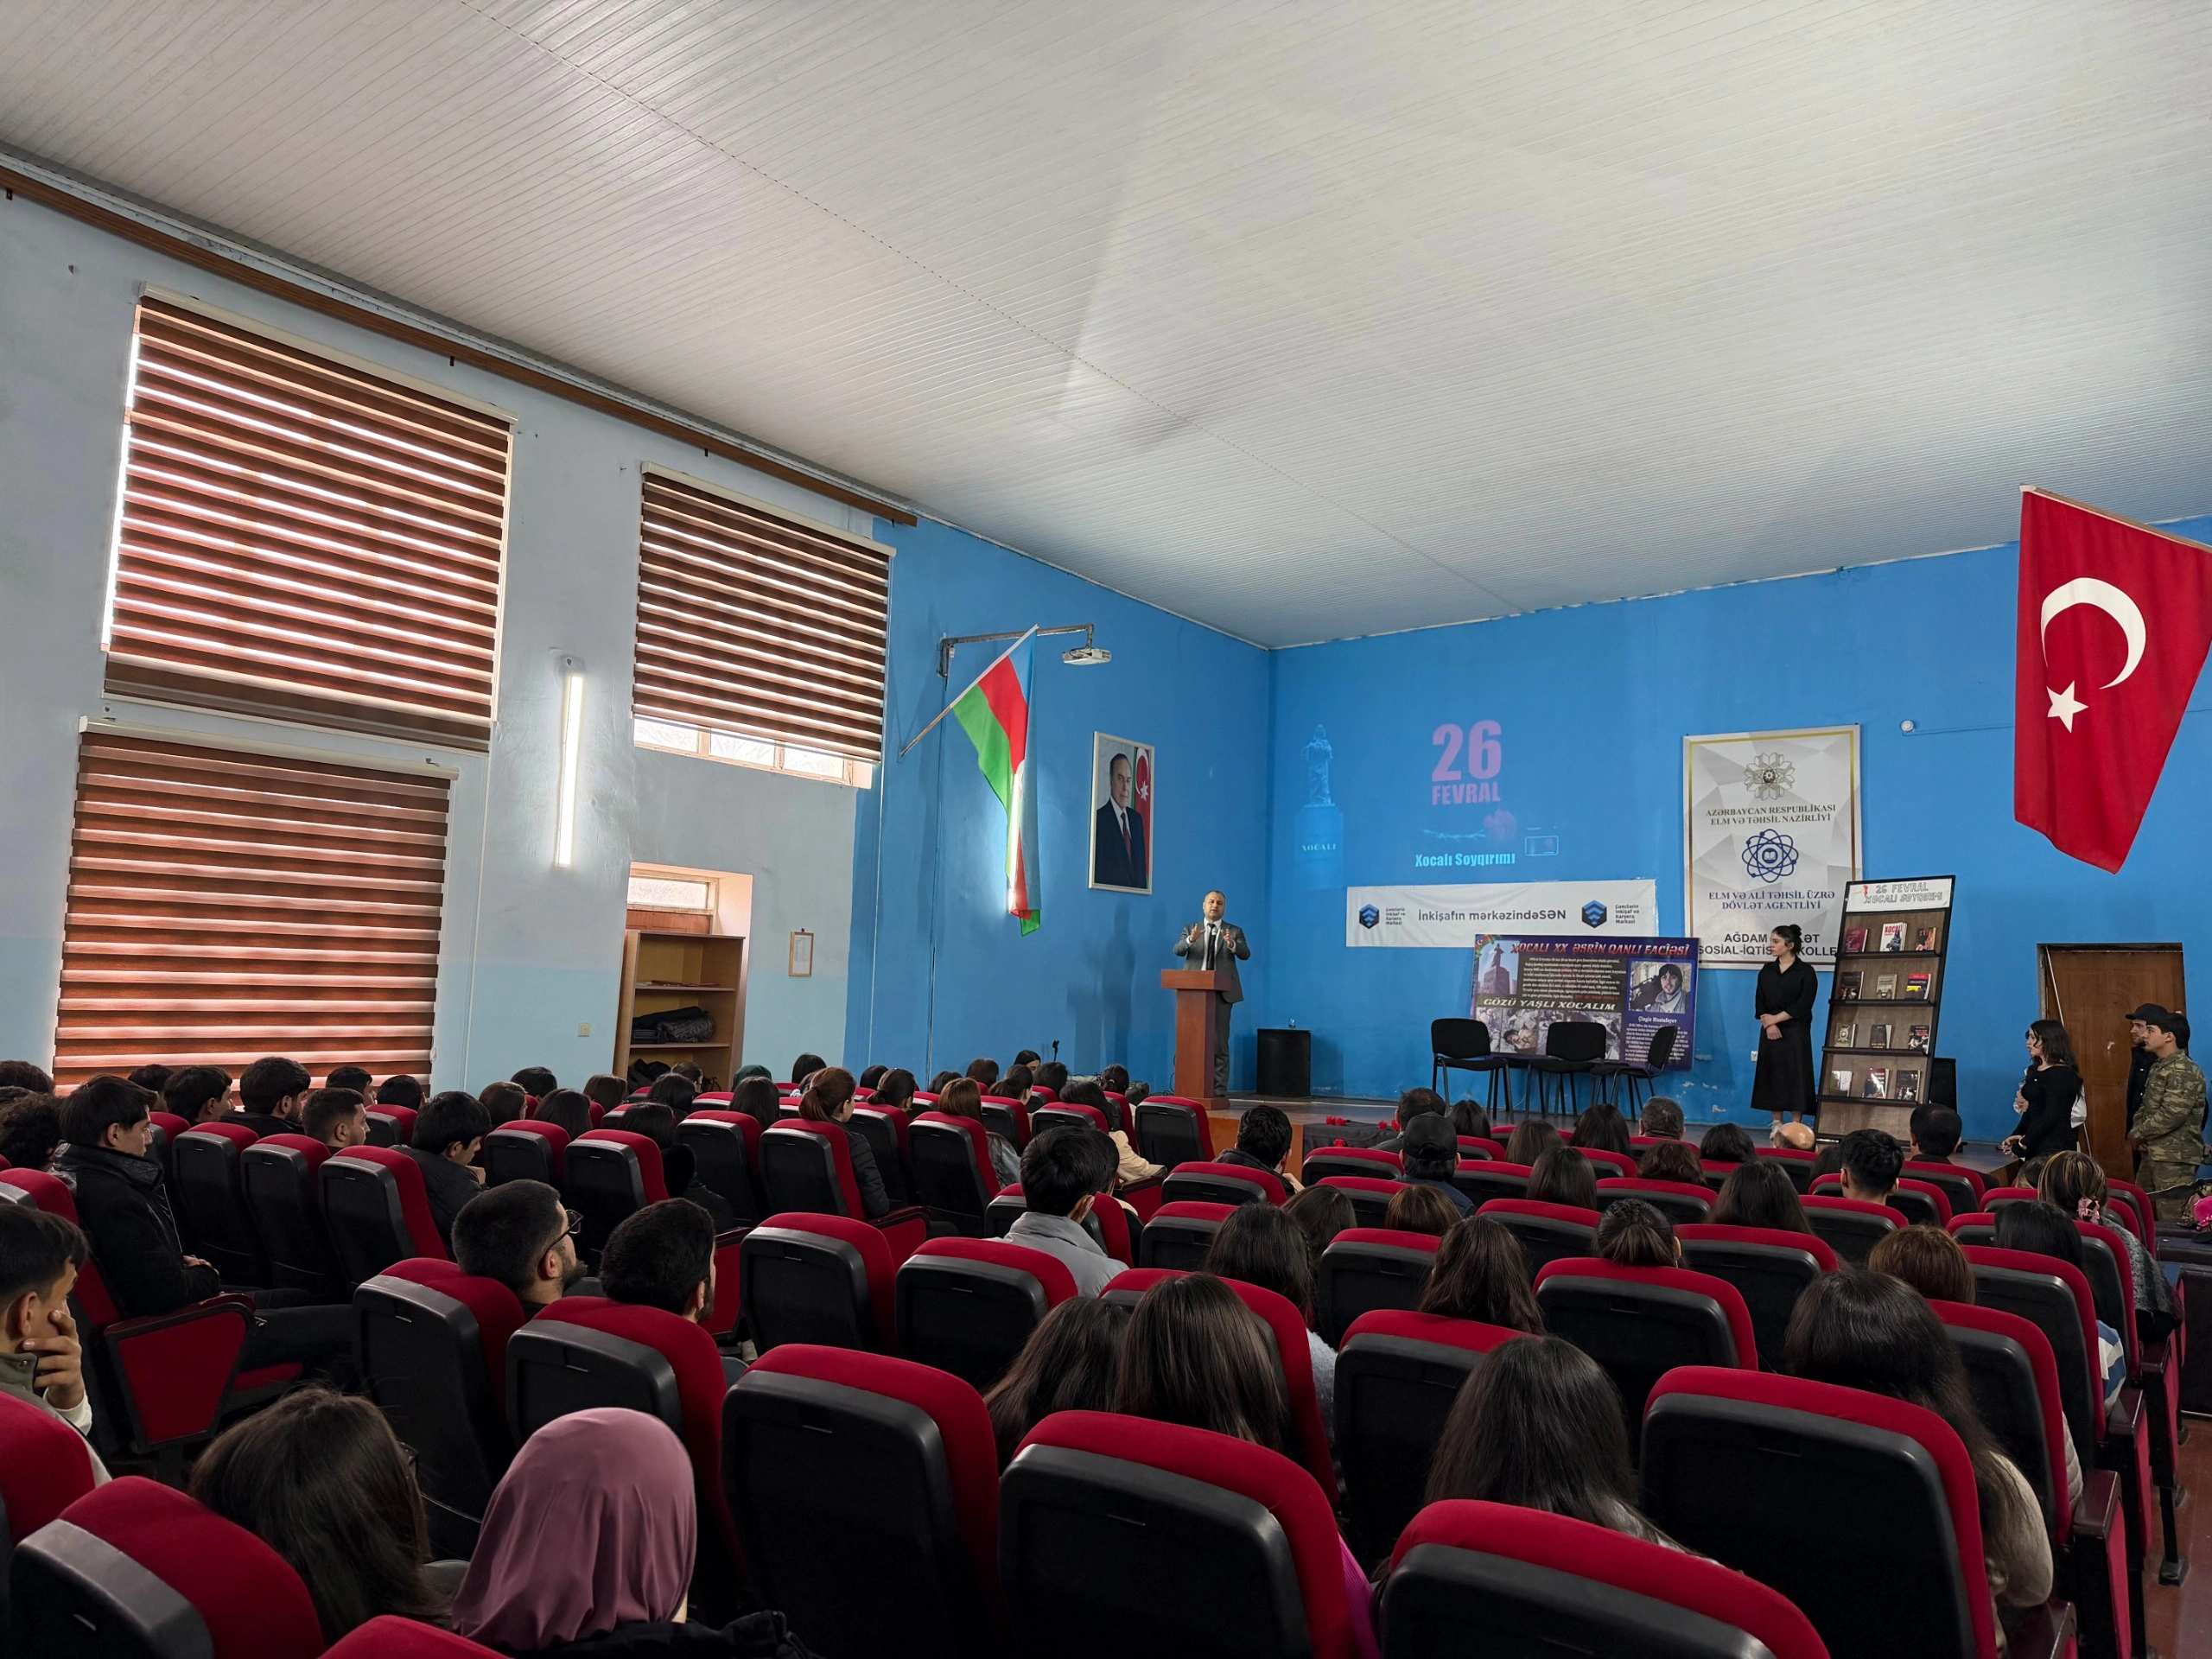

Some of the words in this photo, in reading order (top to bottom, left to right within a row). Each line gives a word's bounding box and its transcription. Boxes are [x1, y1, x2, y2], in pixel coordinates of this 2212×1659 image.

[1432, 720, 1502, 782] 26
[1432, 781, 1501, 805] FEVRAL
[1706, 807, 1767, 817] AZƏRBAYCAN
[1769, 804, 1836, 814] RESPUBLİKASI
[1711, 817, 1731, 825] ELM
[1748, 815, 1780, 824] TƏHSİL
[1782, 812, 1831, 823] NAZİRLİYİ
[1415, 854, 1452, 868] Xocalı
[1455, 853, 1516, 868] Soyqırımı
[1748, 891, 1764, 899] ALİ
[1767, 890, 1804, 899] TƏHSİL
[1807, 889, 1835, 899] ÜZRƏ
[1876, 885, 1888, 893] 26
[1892, 882, 1929, 893] FEVRAL
[1722, 900, 1763, 910] DÖVLƏT
[1764, 899, 1821, 910] AGENTLİYİ
[1864, 893, 1897, 904] XOCALI
[1418, 908, 1465, 922] İnkişafın
[1469, 909, 1567, 921] mərkəzindəSƏN
[1724, 931, 1767, 943] AĞDAM
[1511, 943, 1549, 954] XOCALI
[1554, 943, 1568, 952] XX
[1573, 942, 1606, 953] ƏSRİN
[1608, 944, 1643, 955] QANLI
[1644, 943, 1690, 956] FACİƏSİ
[1699, 944, 1772, 956] SOSİAL-İQTİS
[1798, 946, 1838, 957] KOLLE
[1484, 996, 1516, 1006] GÖZÜ
[1519, 998, 1555, 1008] YAŞLI
[1557, 1001, 1616, 1011] XOCALIM
